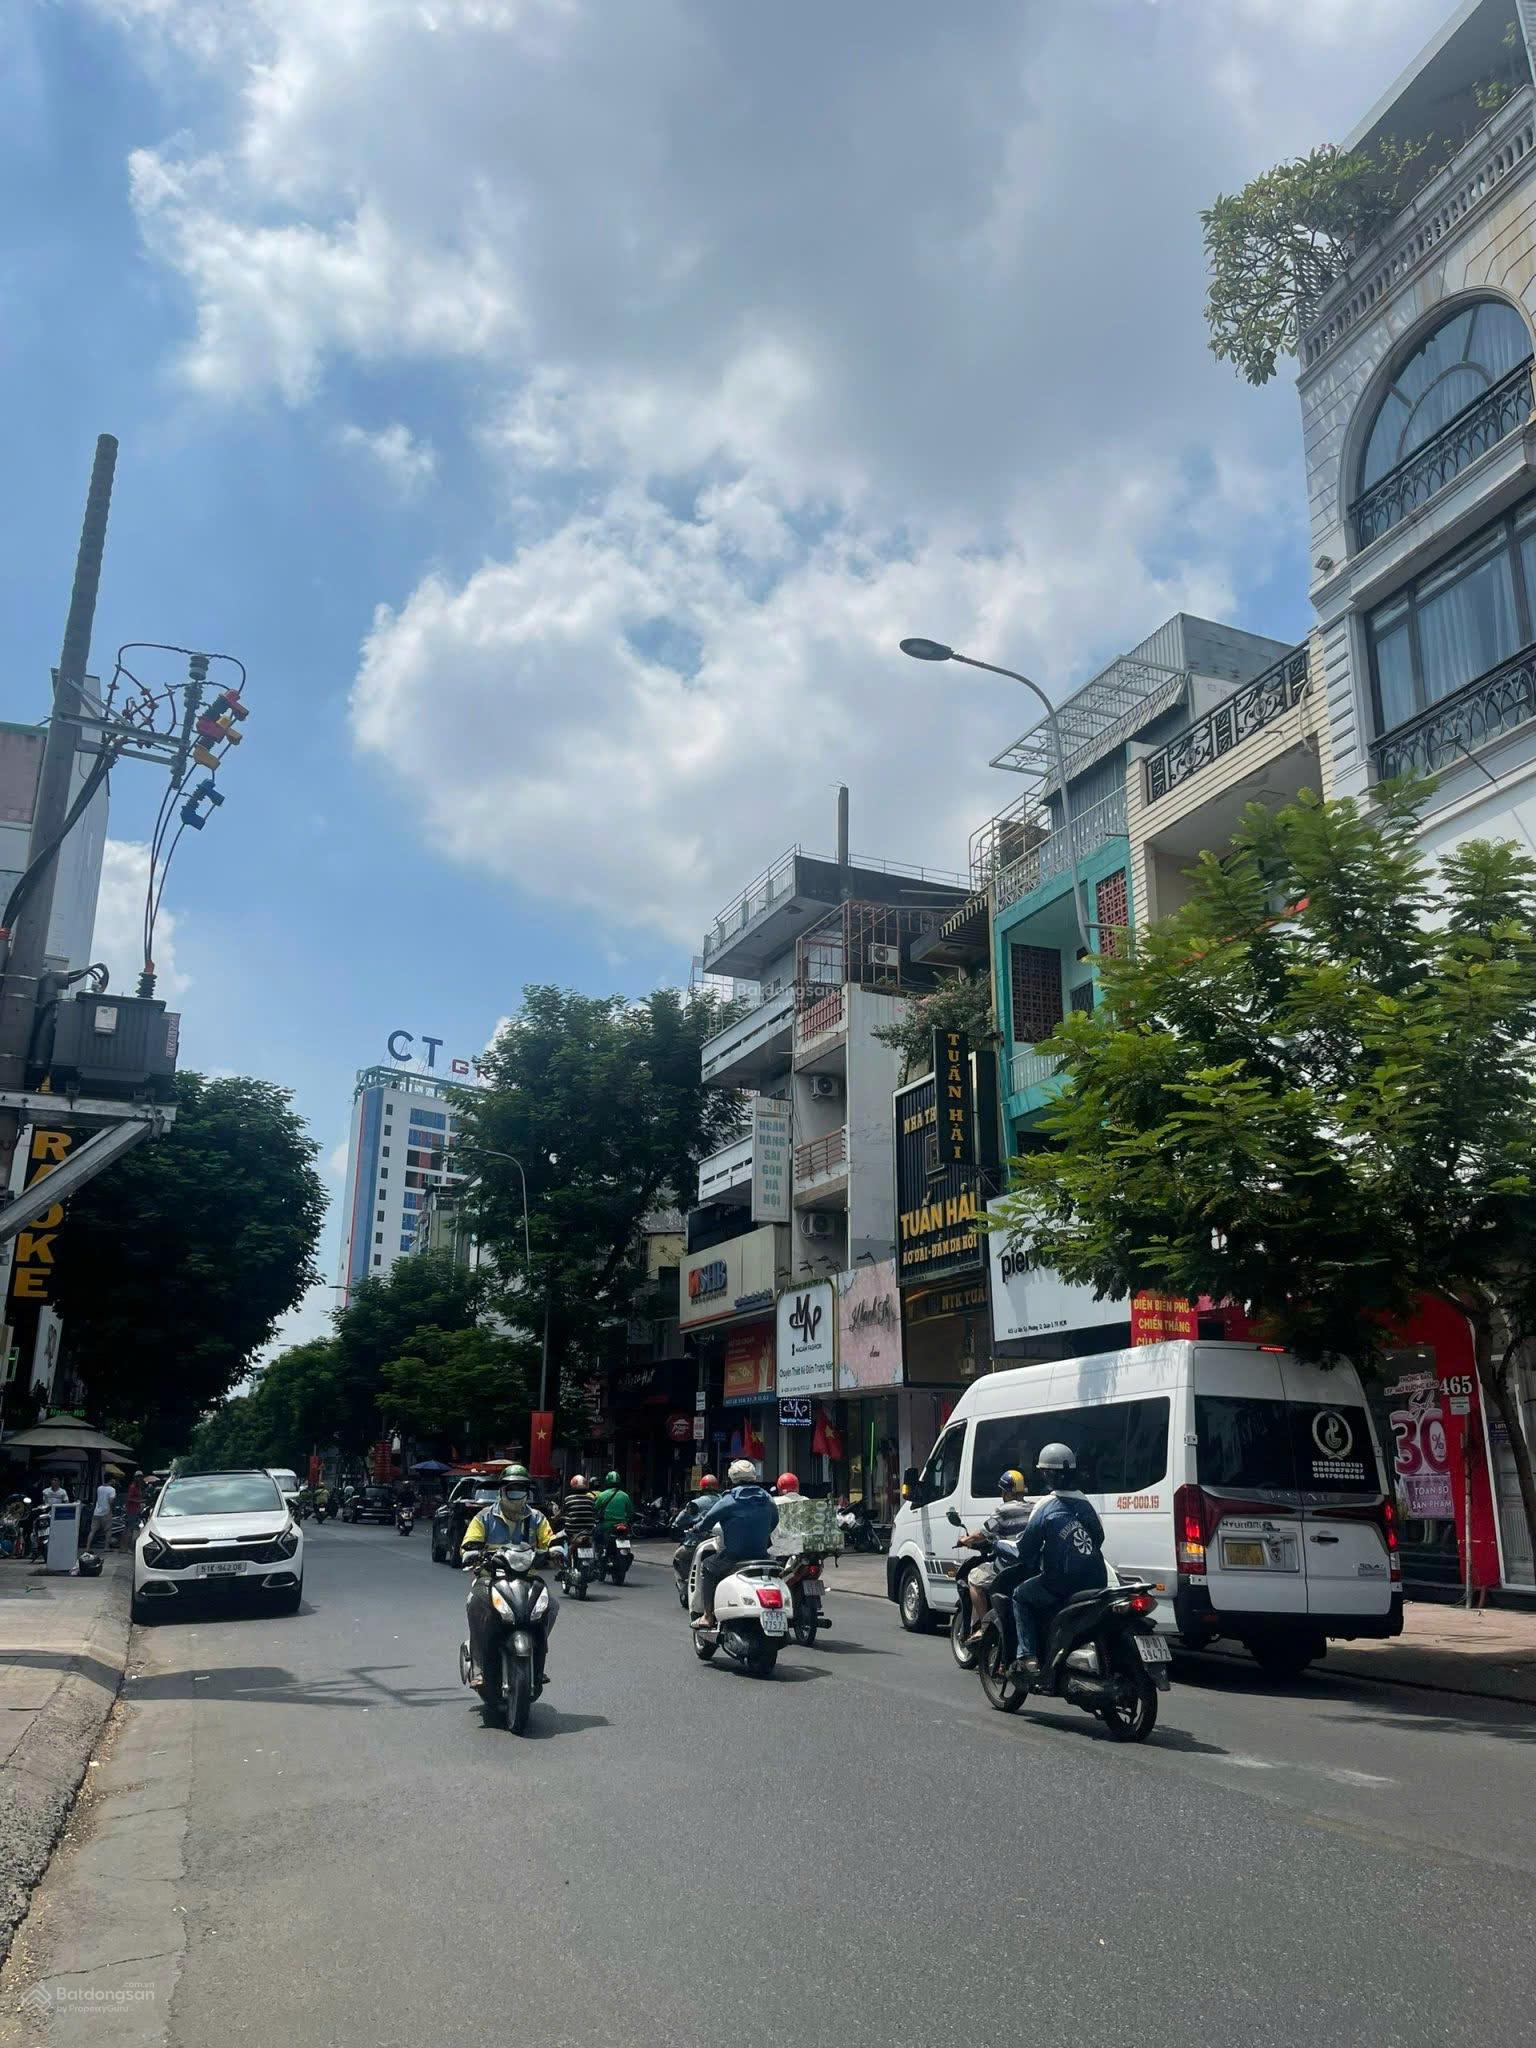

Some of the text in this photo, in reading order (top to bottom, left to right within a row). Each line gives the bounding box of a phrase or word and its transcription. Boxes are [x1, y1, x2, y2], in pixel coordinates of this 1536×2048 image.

[387, 1029, 444, 1068] CT
[900, 1181, 978, 1241] TUẤN HẢI
[1133, 1296, 1153, 1313] ĐIỆN
[1138, 1313, 1163, 1330] CHIẾN
[1440, 1375, 1473, 1396] 465
[1389, 1408, 1451, 1475] 30
